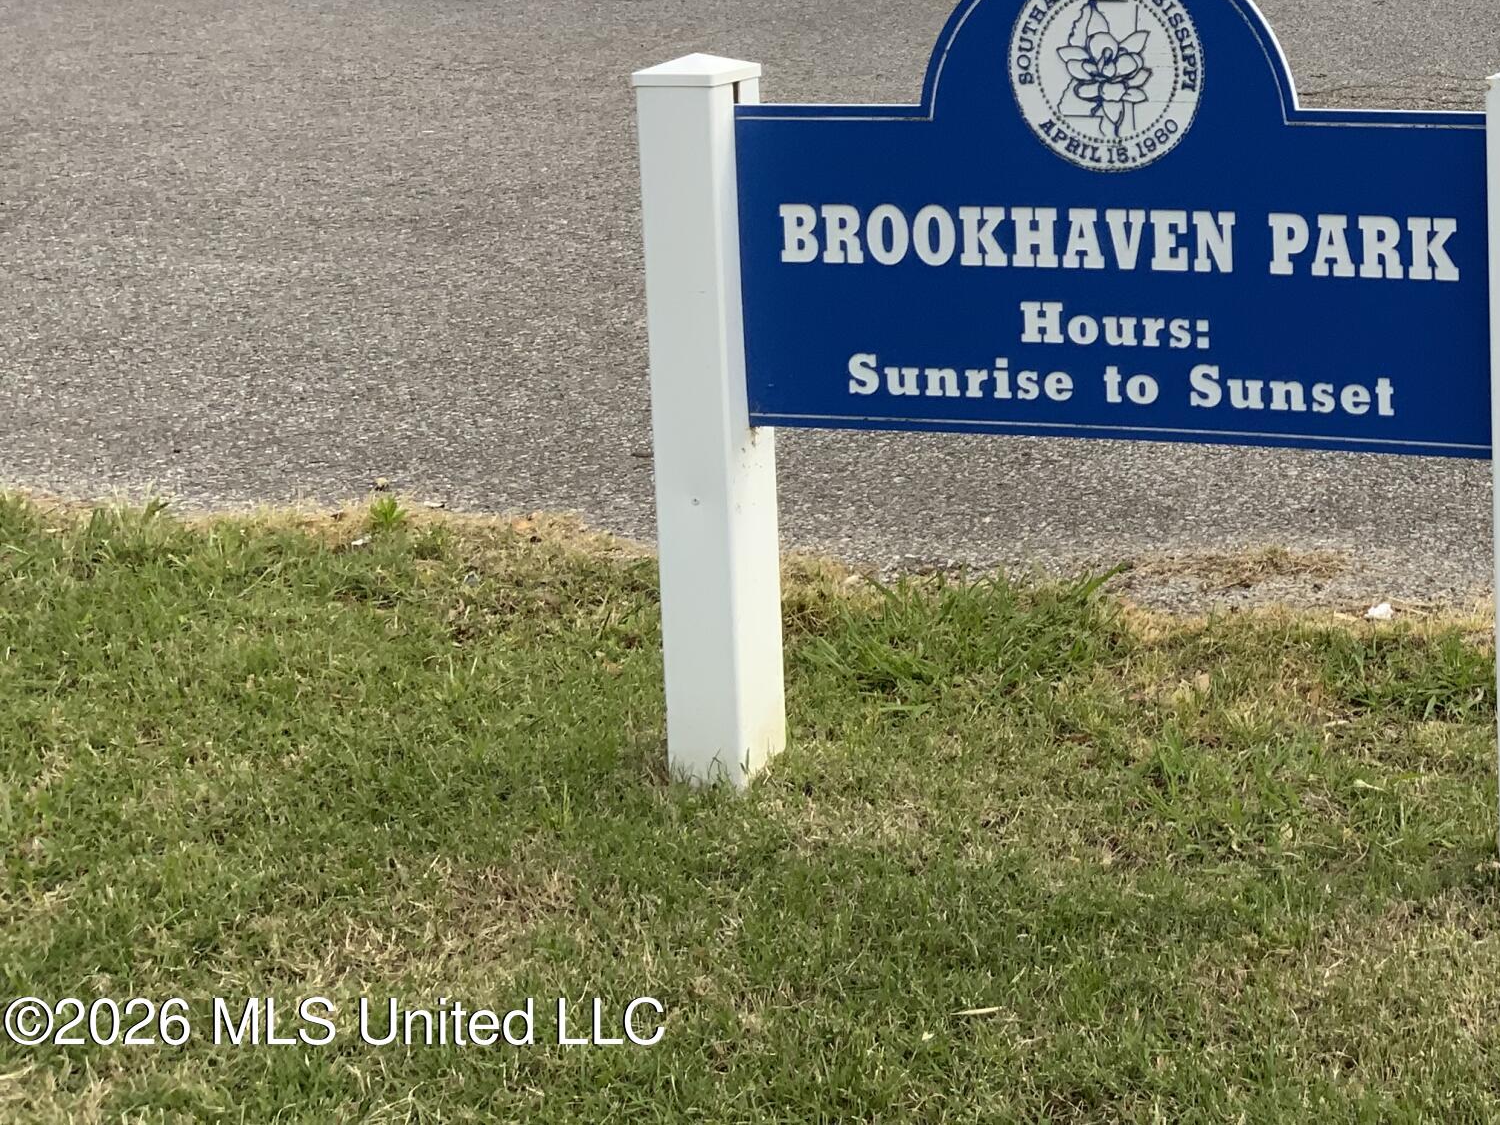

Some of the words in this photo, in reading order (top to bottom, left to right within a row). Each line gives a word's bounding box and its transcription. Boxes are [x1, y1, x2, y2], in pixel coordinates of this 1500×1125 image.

[1038, 118, 1102, 164] APRIL
[778, 203, 1236, 273] BROOKHAVEN
[1267, 212, 1460, 281] PARK
[1019, 300, 1210, 349] Hours:
[847, 352, 1075, 402] Sunrise
[1102, 365, 1159, 405] to
[1189, 363, 1396, 417] Sunset
